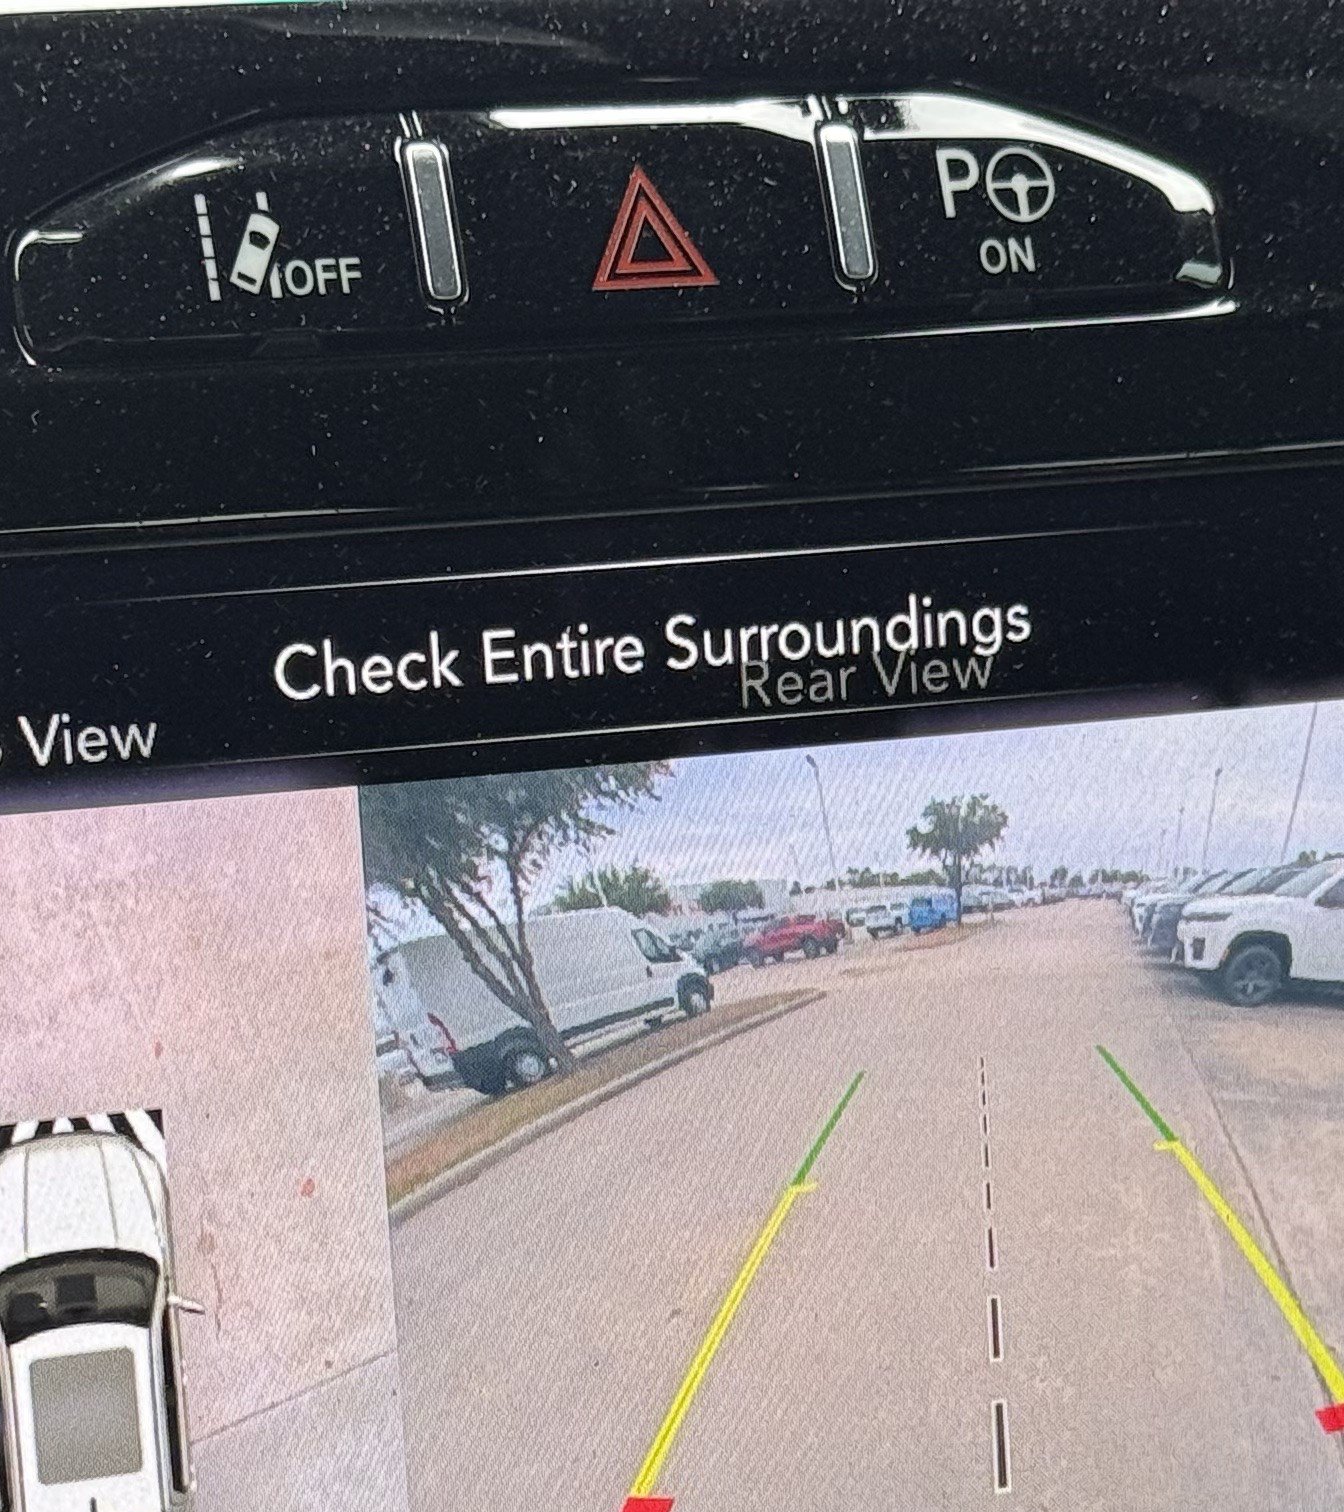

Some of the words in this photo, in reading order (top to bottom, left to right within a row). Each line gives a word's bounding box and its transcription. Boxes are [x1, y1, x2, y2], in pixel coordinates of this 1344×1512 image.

[285, 256, 362, 297] OFF
[978, 236, 1037, 276] ON
[273, 642, 462, 702] Check
[483, 626, 645, 684] Entire
[664, 595, 1032, 670] Surroundings
[740, 658, 857, 708] Rear
[869, 646, 994, 699] View
[18, 712, 157, 768] View
